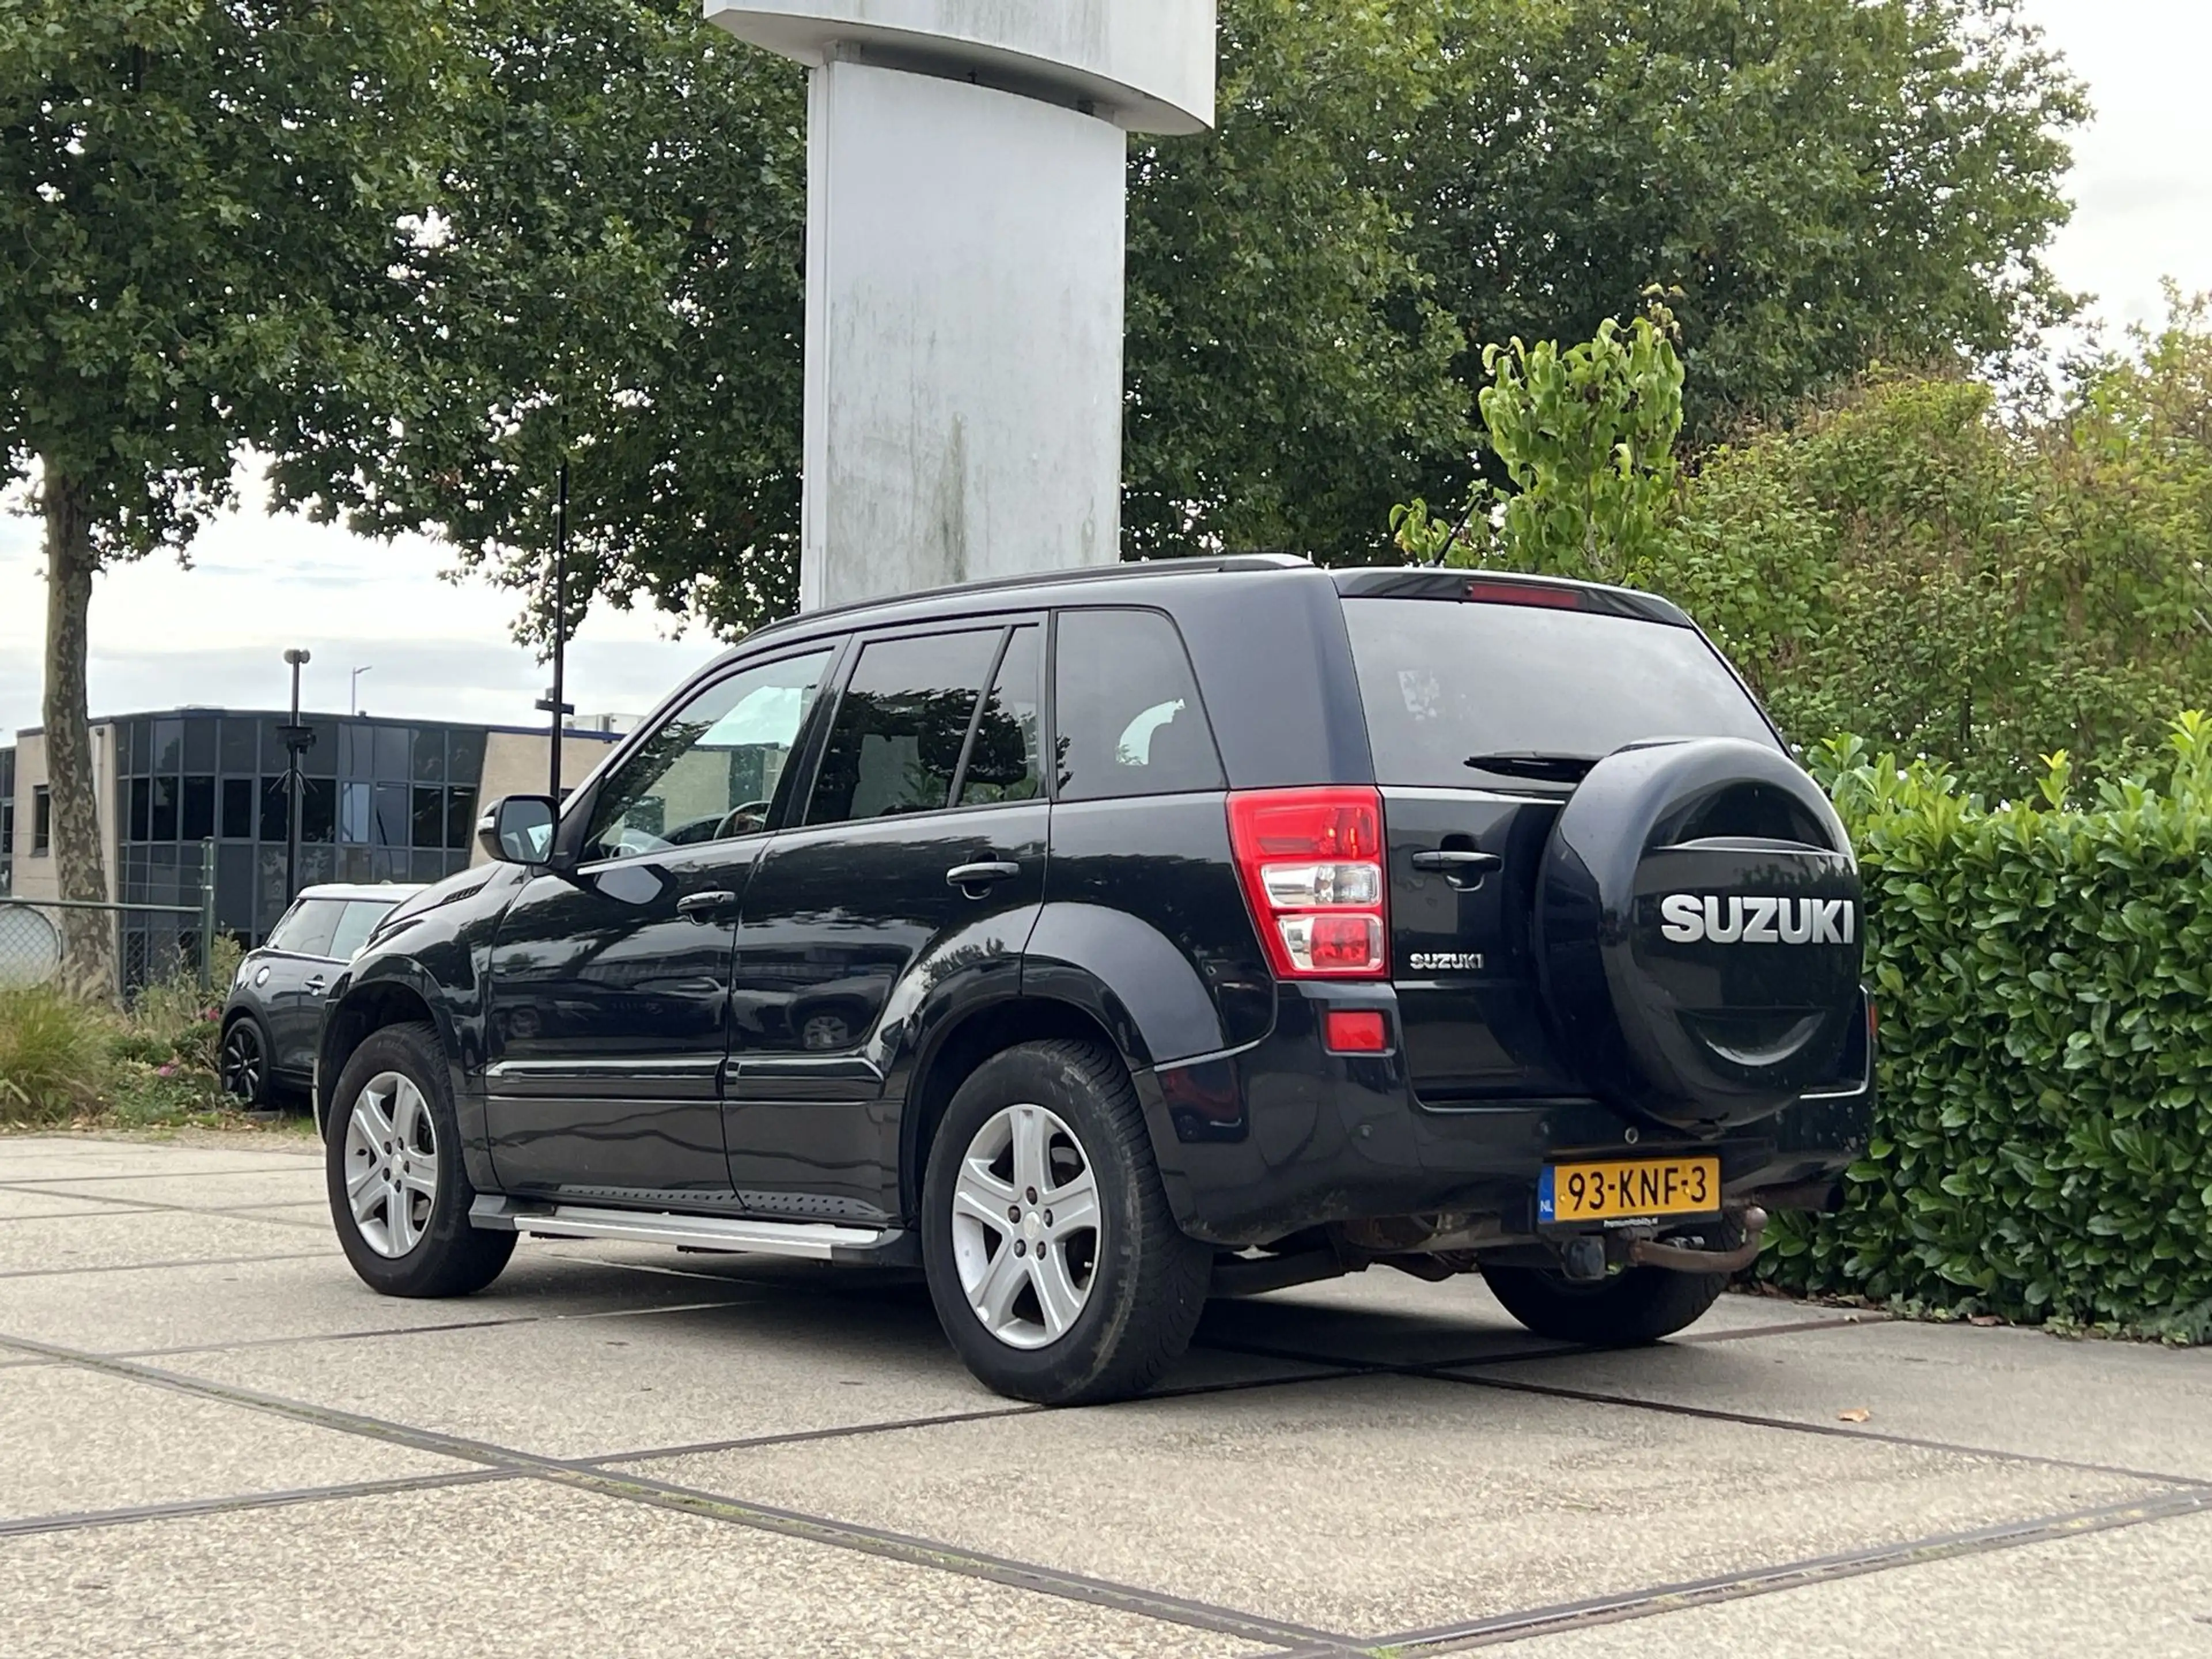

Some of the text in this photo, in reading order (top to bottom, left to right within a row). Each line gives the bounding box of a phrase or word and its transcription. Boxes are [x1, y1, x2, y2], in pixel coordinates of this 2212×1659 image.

[1661, 894, 1854, 944] SUZUKI
[1410, 953, 1484, 969] SUZUKI
[1568, 1166, 1706, 1211] 93-KNF-3
[1540, 1200, 1553, 1213] NL
